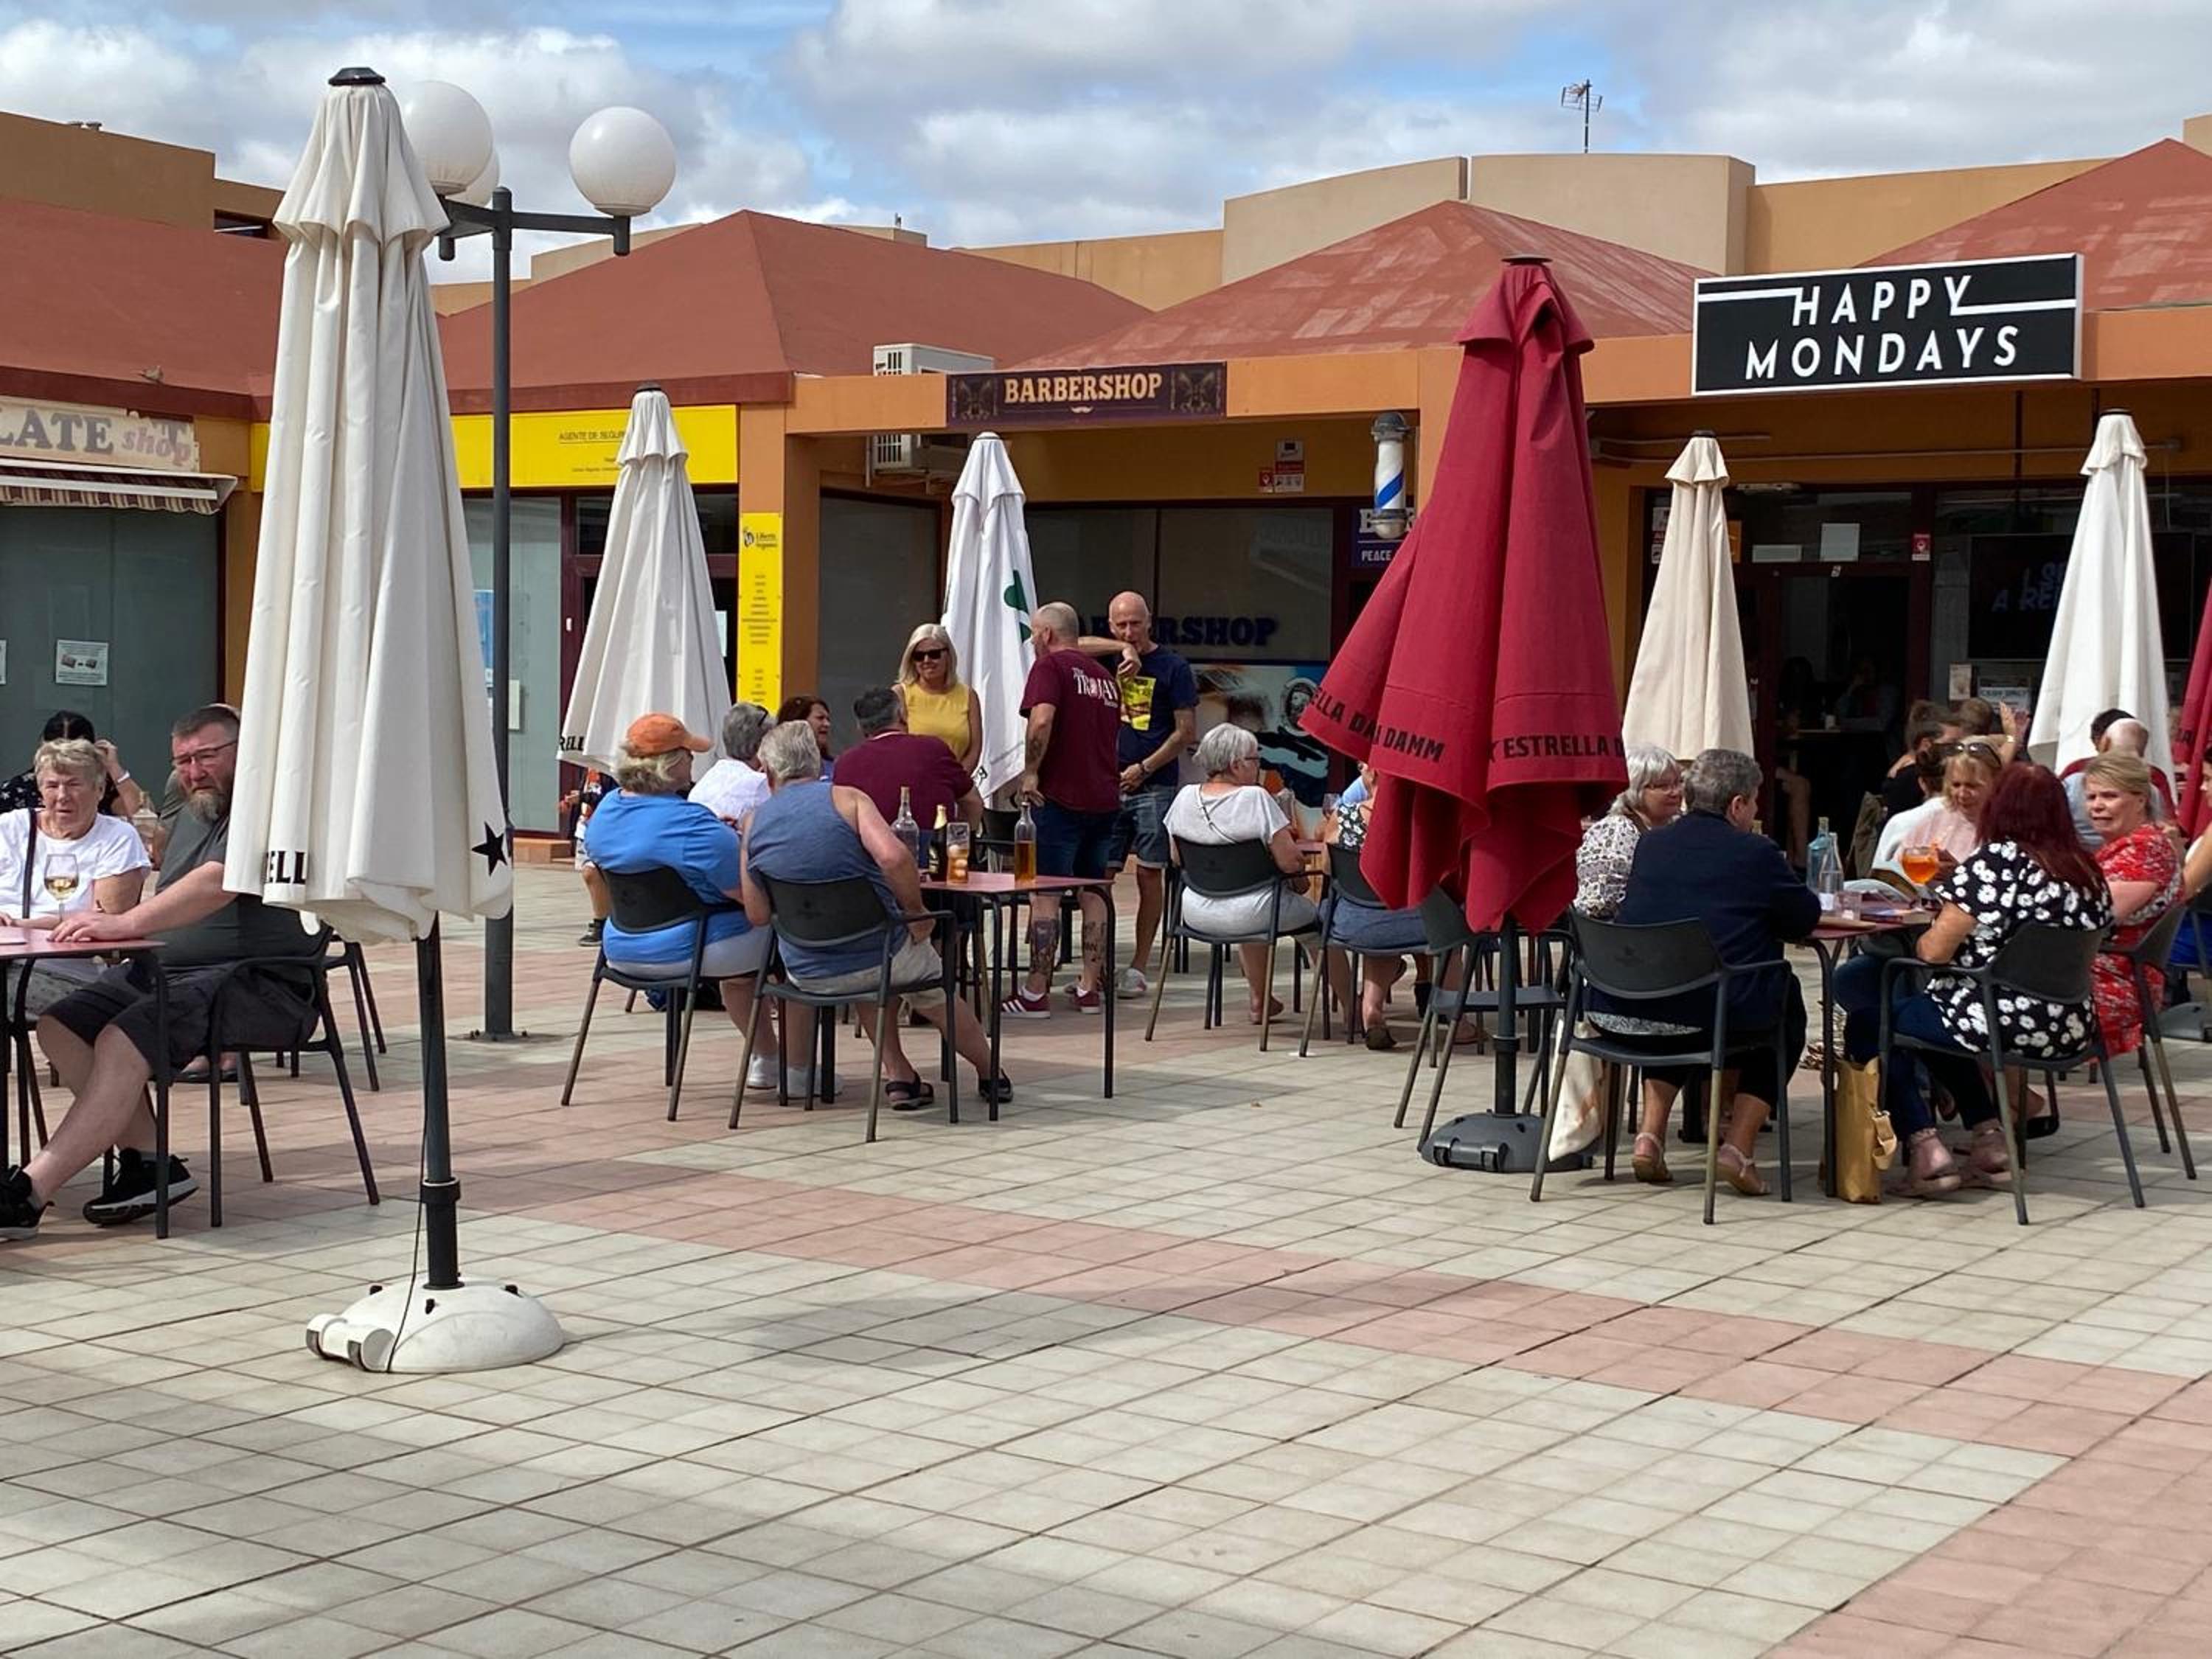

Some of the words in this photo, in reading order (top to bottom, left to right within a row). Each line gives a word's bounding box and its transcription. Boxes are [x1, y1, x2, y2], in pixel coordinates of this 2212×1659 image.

[1792, 275, 1972, 327] HAPPY
[1745, 325, 2018, 380] MONDAYS
[1004, 373, 1162, 403] BARBERSHOP
[121, 425, 191, 466] shop
[1362, 550, 1392, 562] PEACE
[1383, 727, 1445, 762] DAMM
[1503, 735, 1609, 758] ESTRELLA
